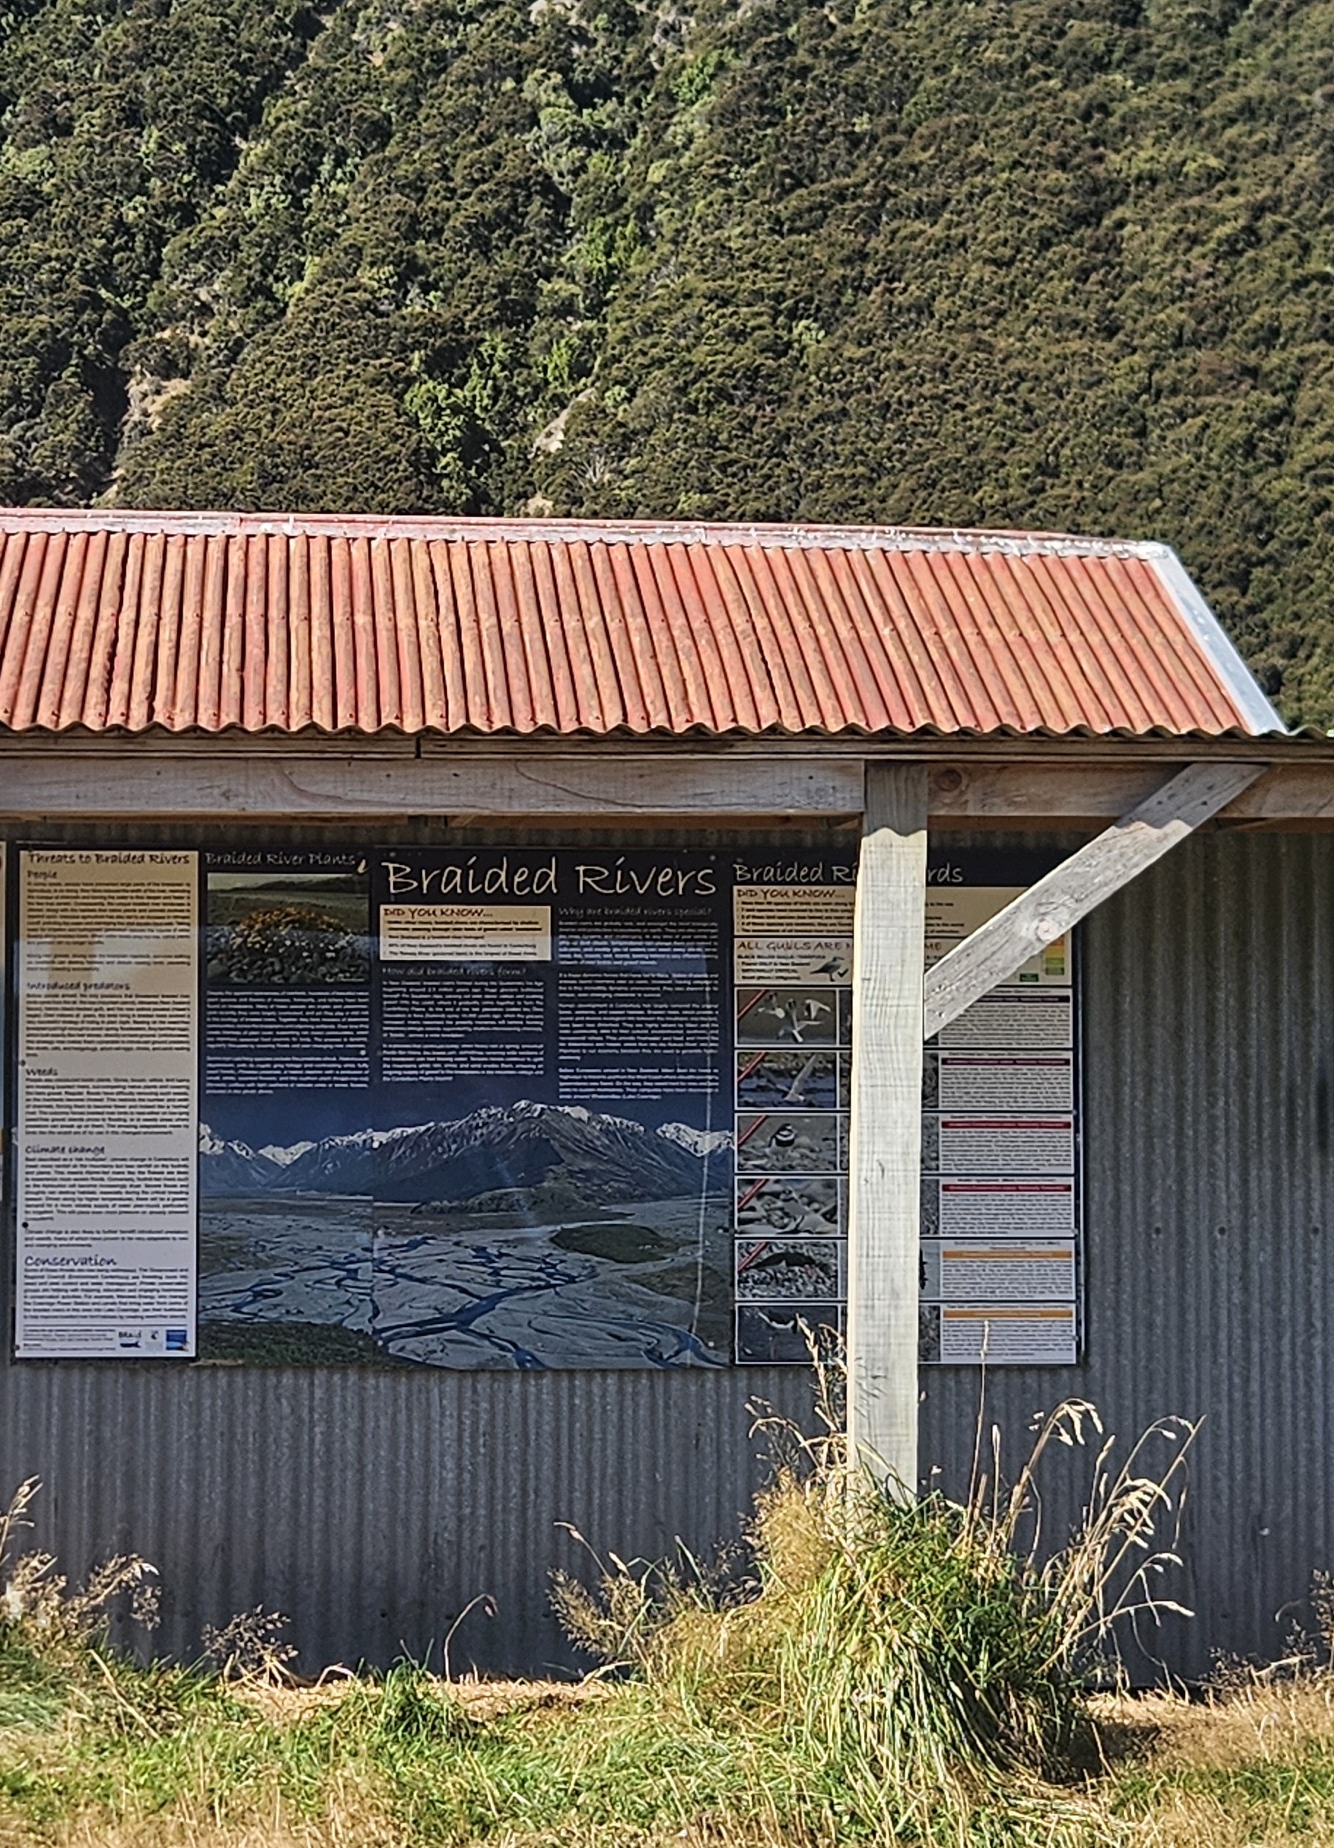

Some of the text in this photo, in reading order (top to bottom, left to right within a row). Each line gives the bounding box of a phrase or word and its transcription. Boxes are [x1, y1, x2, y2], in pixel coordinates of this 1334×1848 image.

[28, 852, 190, 865] Threats to Braided Rivers
[205, 852, 356, 866] Braided River Plants
[381, 856, 717, 897] Braided Rivers
[733, 862, 823, 883] Braided
[927, 863, 963, 883] rds
[737, 889, 758, 898] DID
[761, 889, 791, 900] YOU
[384, 908, 405, 917] DID
[408, 908, 437, 919] YOU
[737, 941, 762, 950] ALL
[814, 941, 841, 950] ARE
[27, 982, 130, 992] Introduced predators
[25, 1068, 58, 1077] Weeds
[24, 1254, 117, 1267] Conservation
